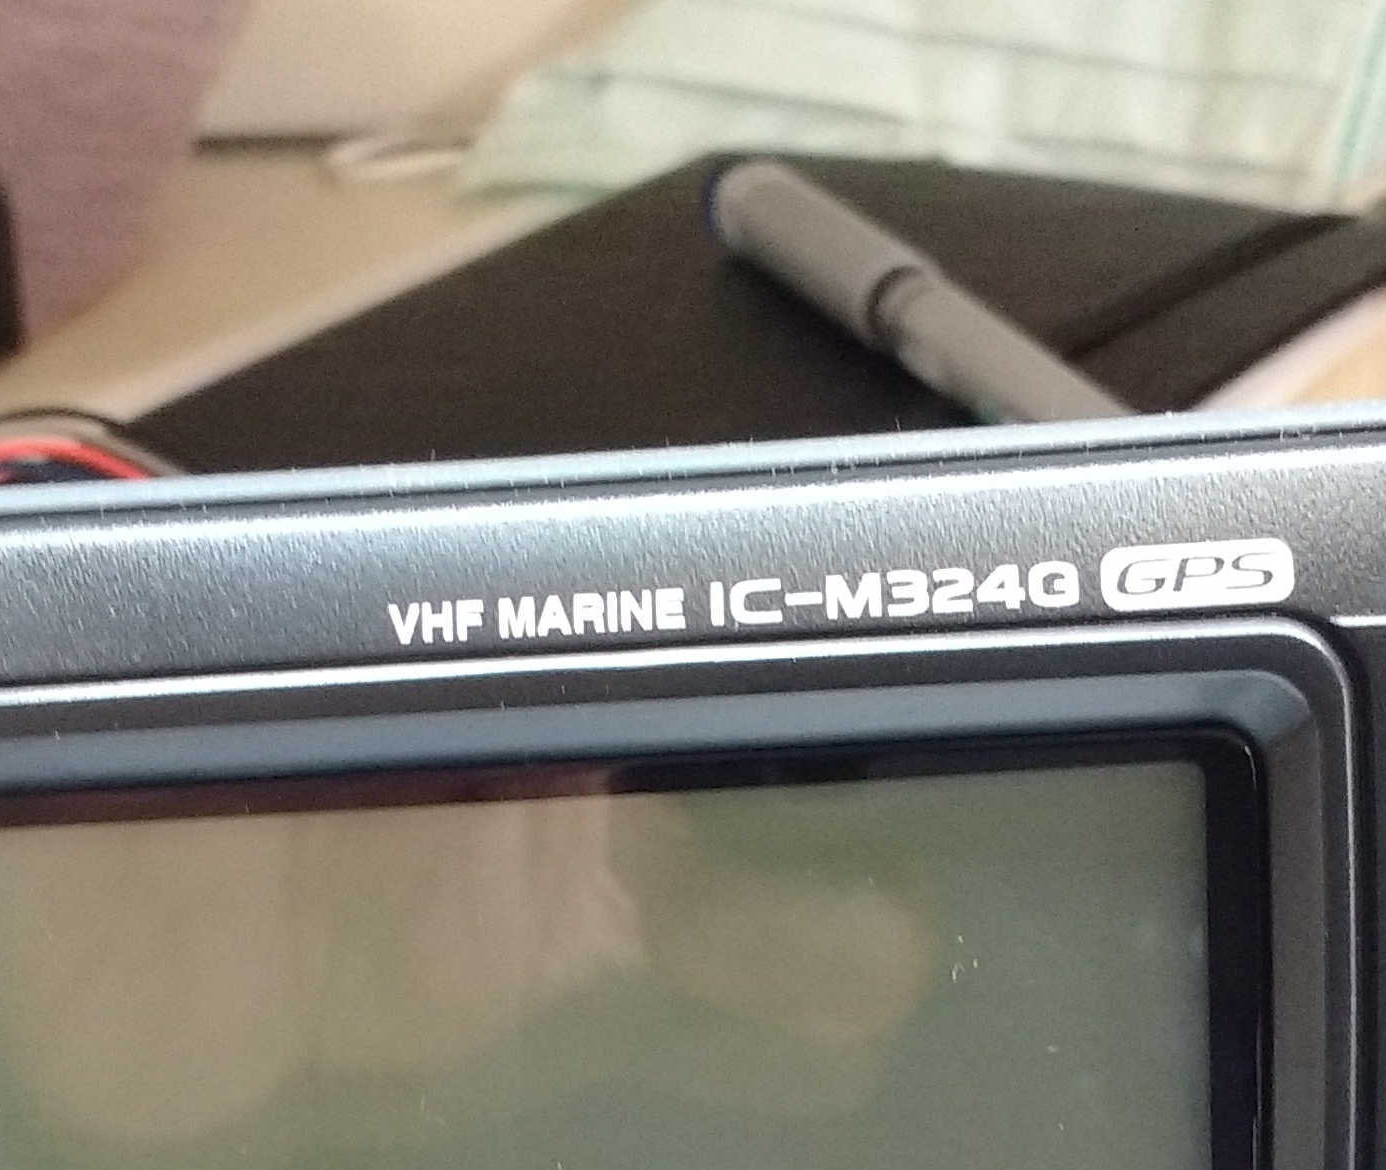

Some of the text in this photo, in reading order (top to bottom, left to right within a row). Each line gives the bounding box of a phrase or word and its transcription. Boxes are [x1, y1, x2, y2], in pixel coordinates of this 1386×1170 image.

[389, 547, 1277, 646] VHF MARINE IC-M324G GPS
